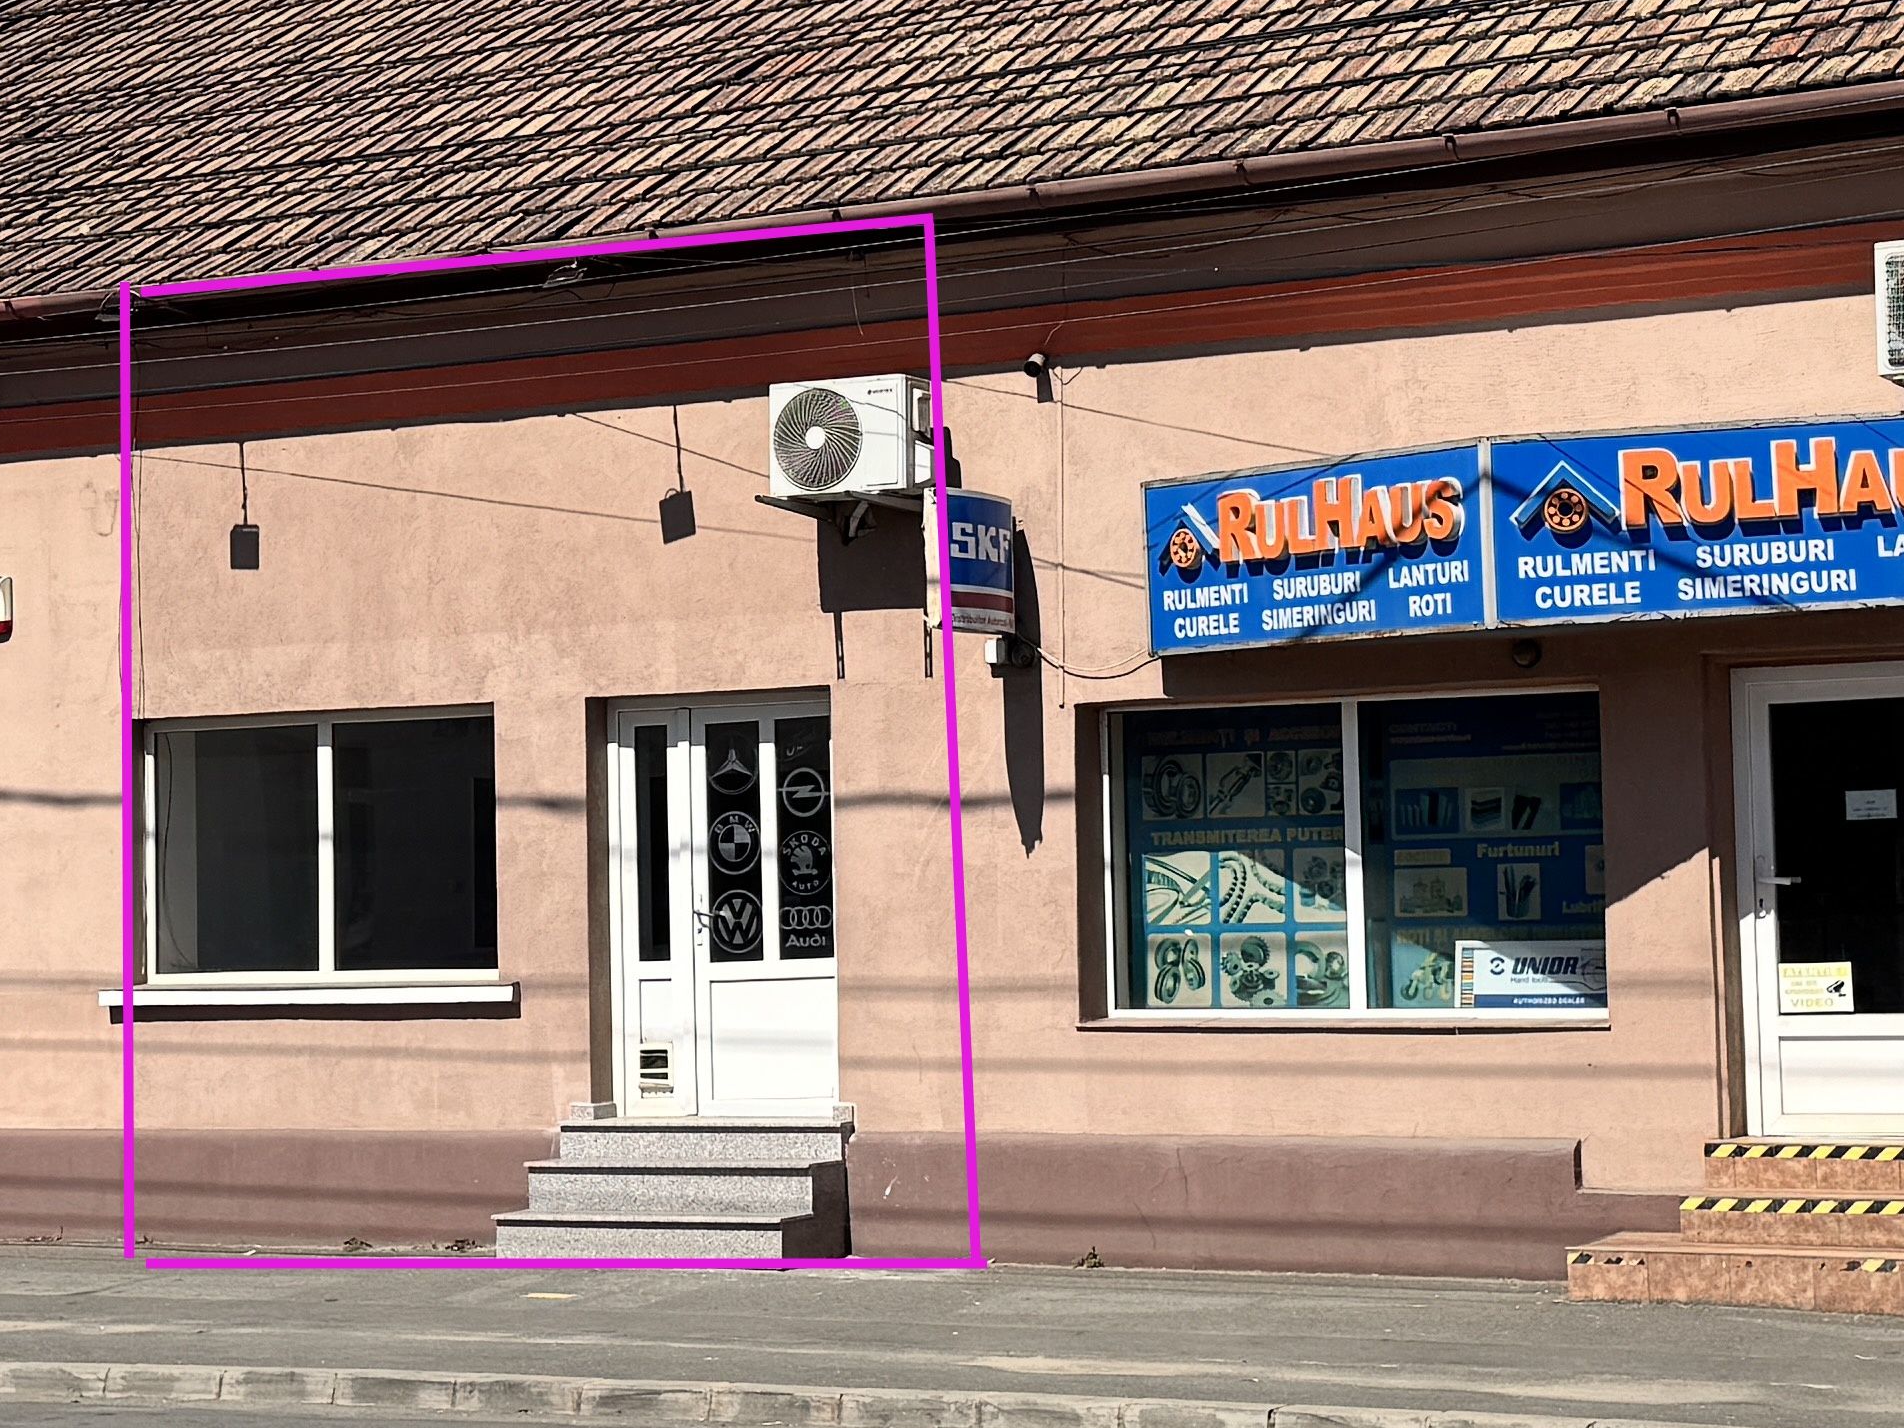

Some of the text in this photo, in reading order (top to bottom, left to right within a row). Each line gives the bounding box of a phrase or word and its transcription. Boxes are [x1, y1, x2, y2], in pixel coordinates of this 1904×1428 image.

[951, 522, 1011, 563] SKF
[1518, 549, 1656, 579] RULMENTI
[1696, 539, 1835, 569] SURUBURI
[1163, 560, 1469, 611] RULMENTI SURUBURI LANTURI
[1535, 581, 1641, 609] CURELE
[1678, 569, 1856, 601] SIMERINGURI
[1174, 593, 1452, 639] CURELE SIMERINGURI ROTI
[785, 934, 826, 947] Audi
[1512, 956, 1580, 975] UNIOR
[1791, 998, 1834, 1008] VIDEO
